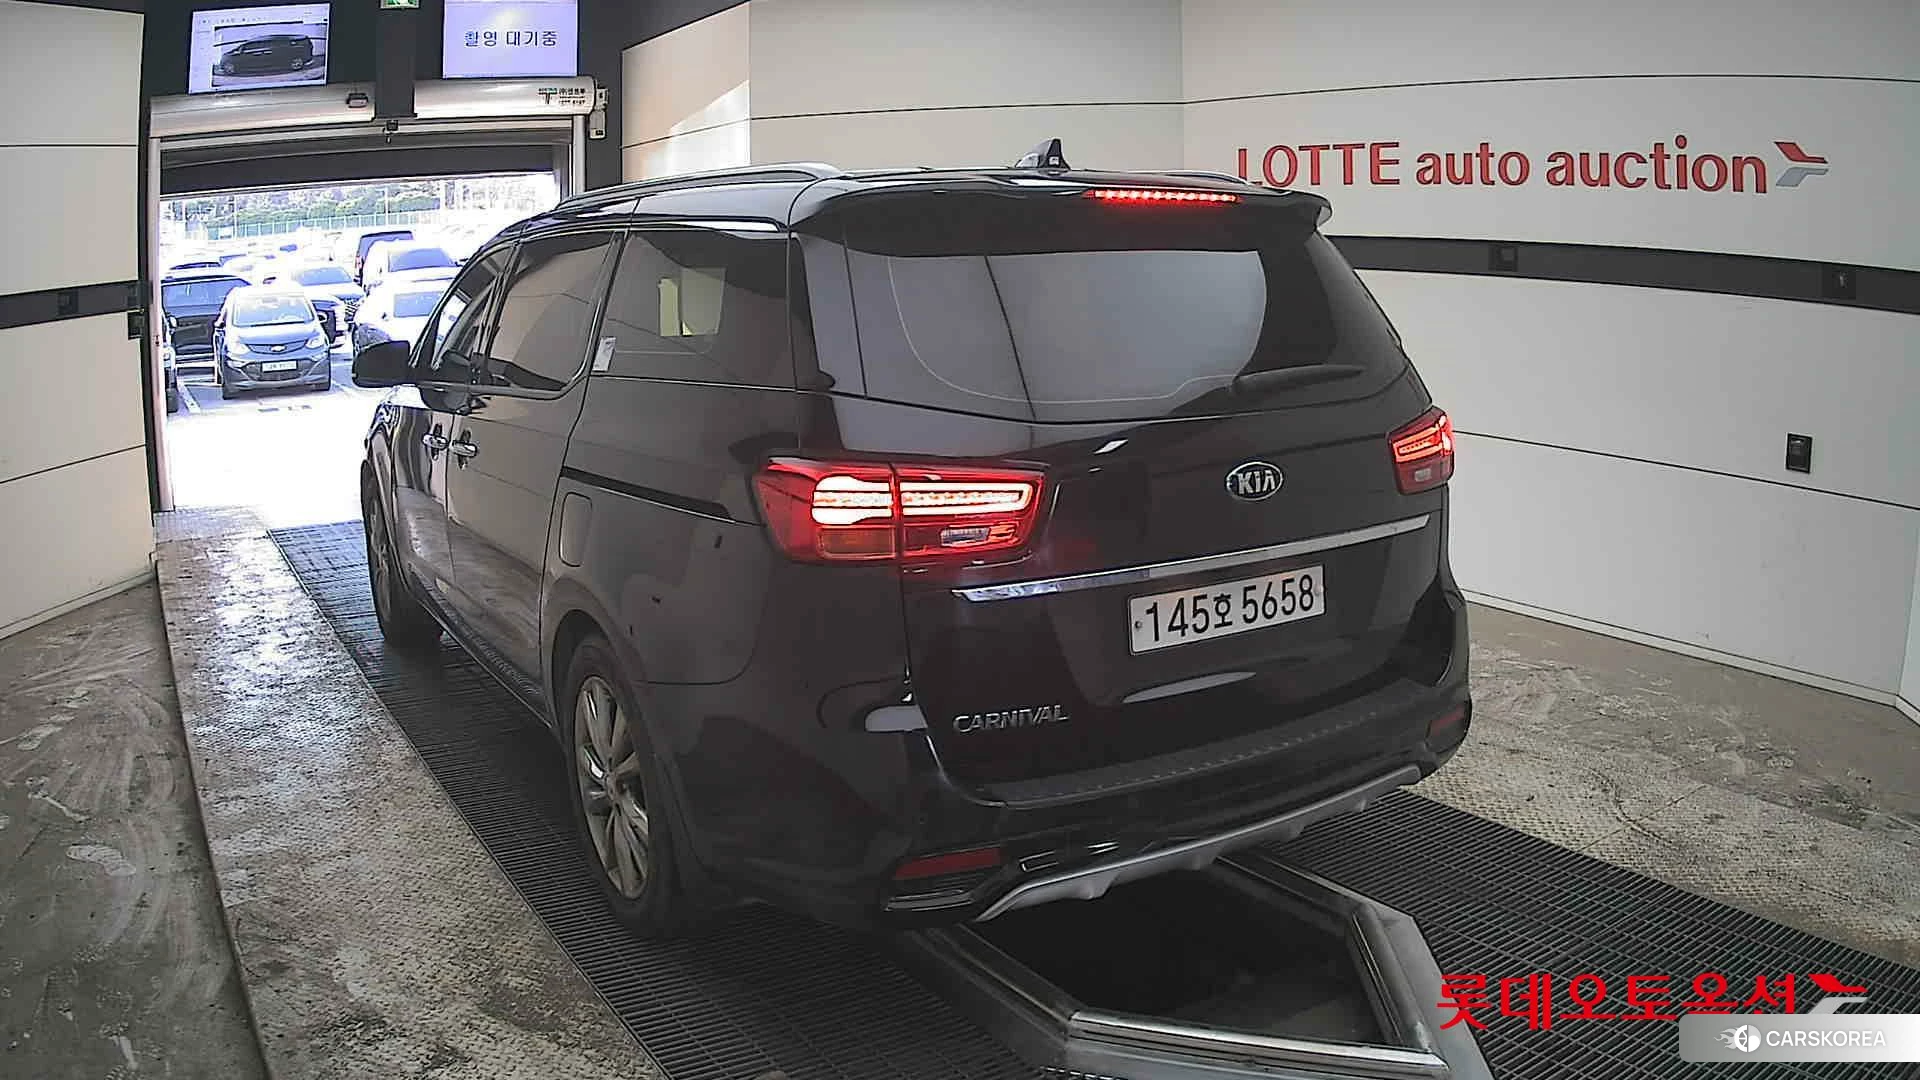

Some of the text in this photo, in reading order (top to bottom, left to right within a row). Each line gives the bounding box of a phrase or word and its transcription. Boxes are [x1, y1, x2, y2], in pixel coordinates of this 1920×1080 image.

[506, 31, 558, 47] 대기중
[1237, 134, 1767, 194] LOTTE auto auction
[1238, 469, 1276, 494] KIA
[1146, 574, 1314, 642] 145호 5658
[953, 704, 1069, 733] CARNIVAL
